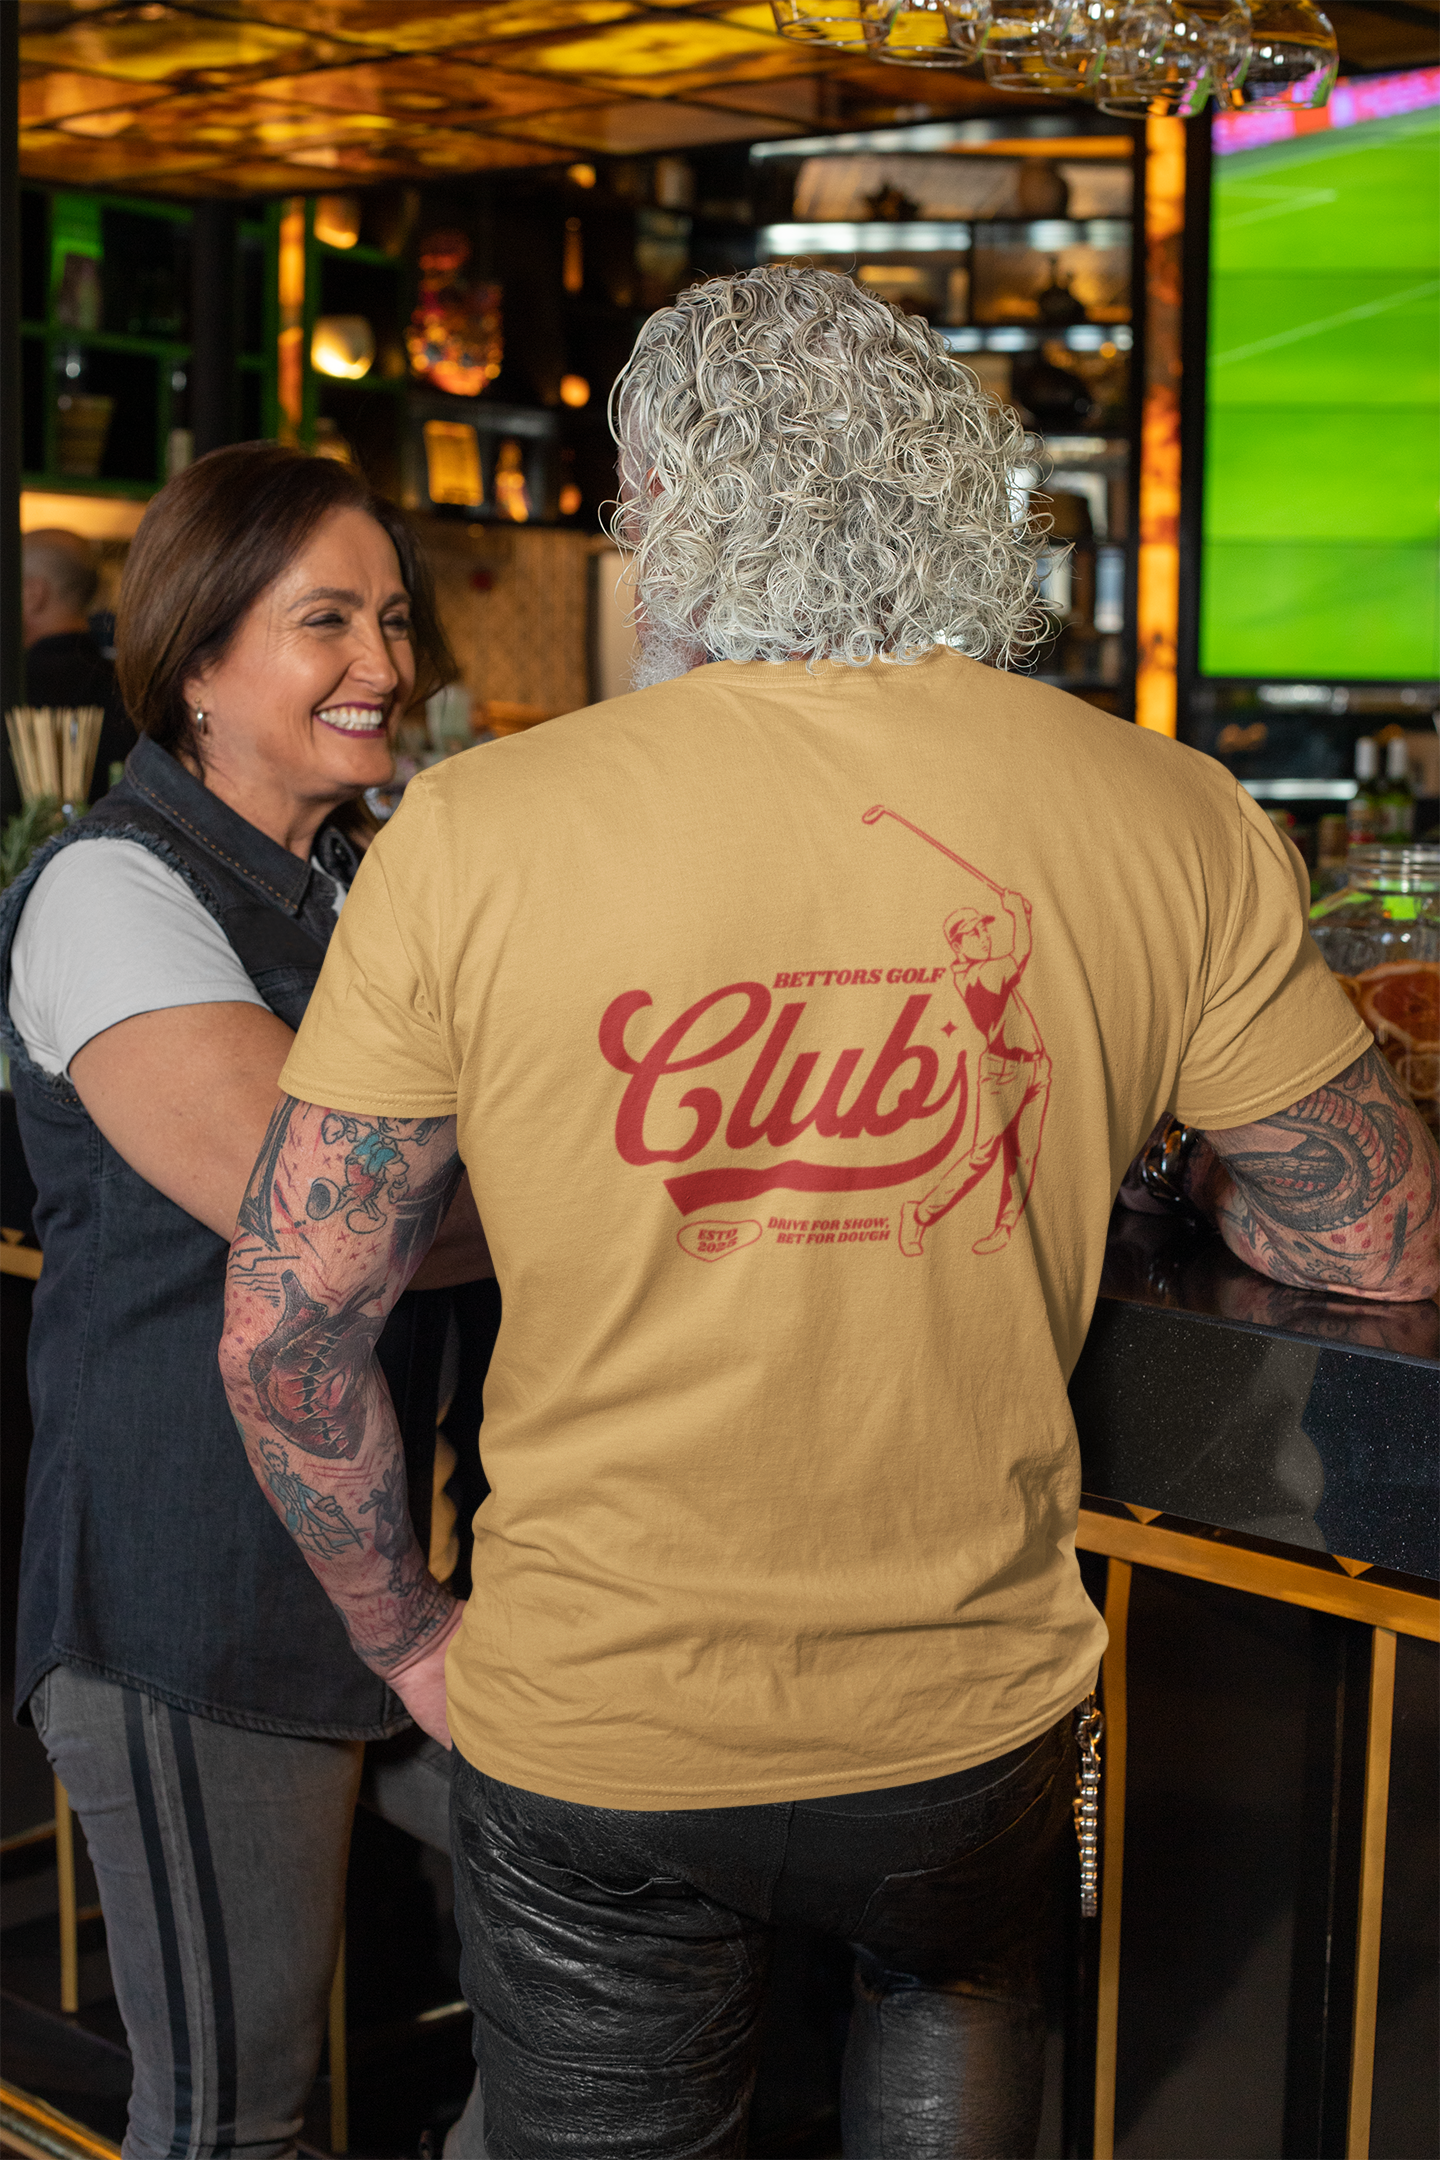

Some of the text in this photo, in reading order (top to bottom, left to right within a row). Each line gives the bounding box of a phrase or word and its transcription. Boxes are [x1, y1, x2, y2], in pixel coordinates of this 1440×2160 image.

[773, 967, 946, 989] BETTORS GOLF
[599, 982, 967, 1170] Club
[767, 1216, 890, 1231] DRIVE FOR SHOW,
[697, 1228, 738, 1242] ESTD
[776, 1230, 891, 1245] BET FOR DOUGH
[697, 1236, 739, 1253] 2025
